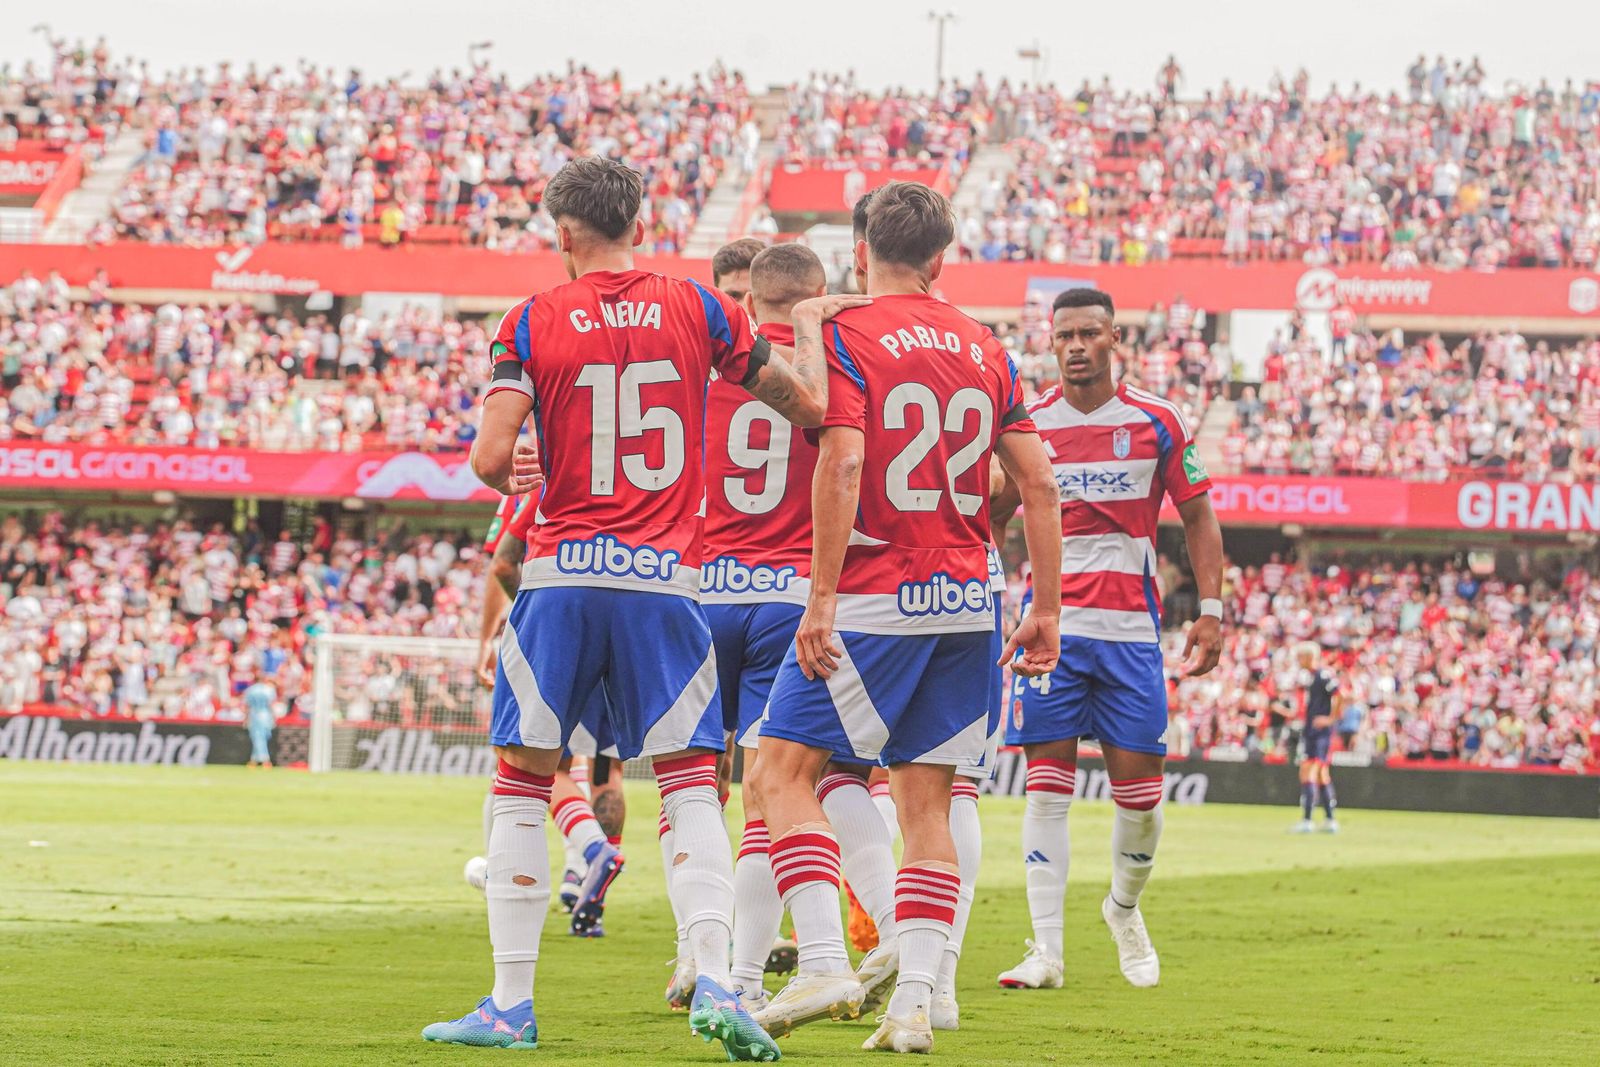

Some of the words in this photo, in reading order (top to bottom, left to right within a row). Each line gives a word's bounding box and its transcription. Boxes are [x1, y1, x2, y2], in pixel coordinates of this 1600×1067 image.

[878, 325, 961, 360] PABLO
[573, 359, 686, 497] 15
[882, 382, 994, 517] 22
[723, 400, 792, 515] 9
[1457, 480, 1600, 529] GRAN
[558, 535, 680, 581] wiber
[0, 714, 211, 769] Alhambra
[357, 726, 498, 777] Alham
